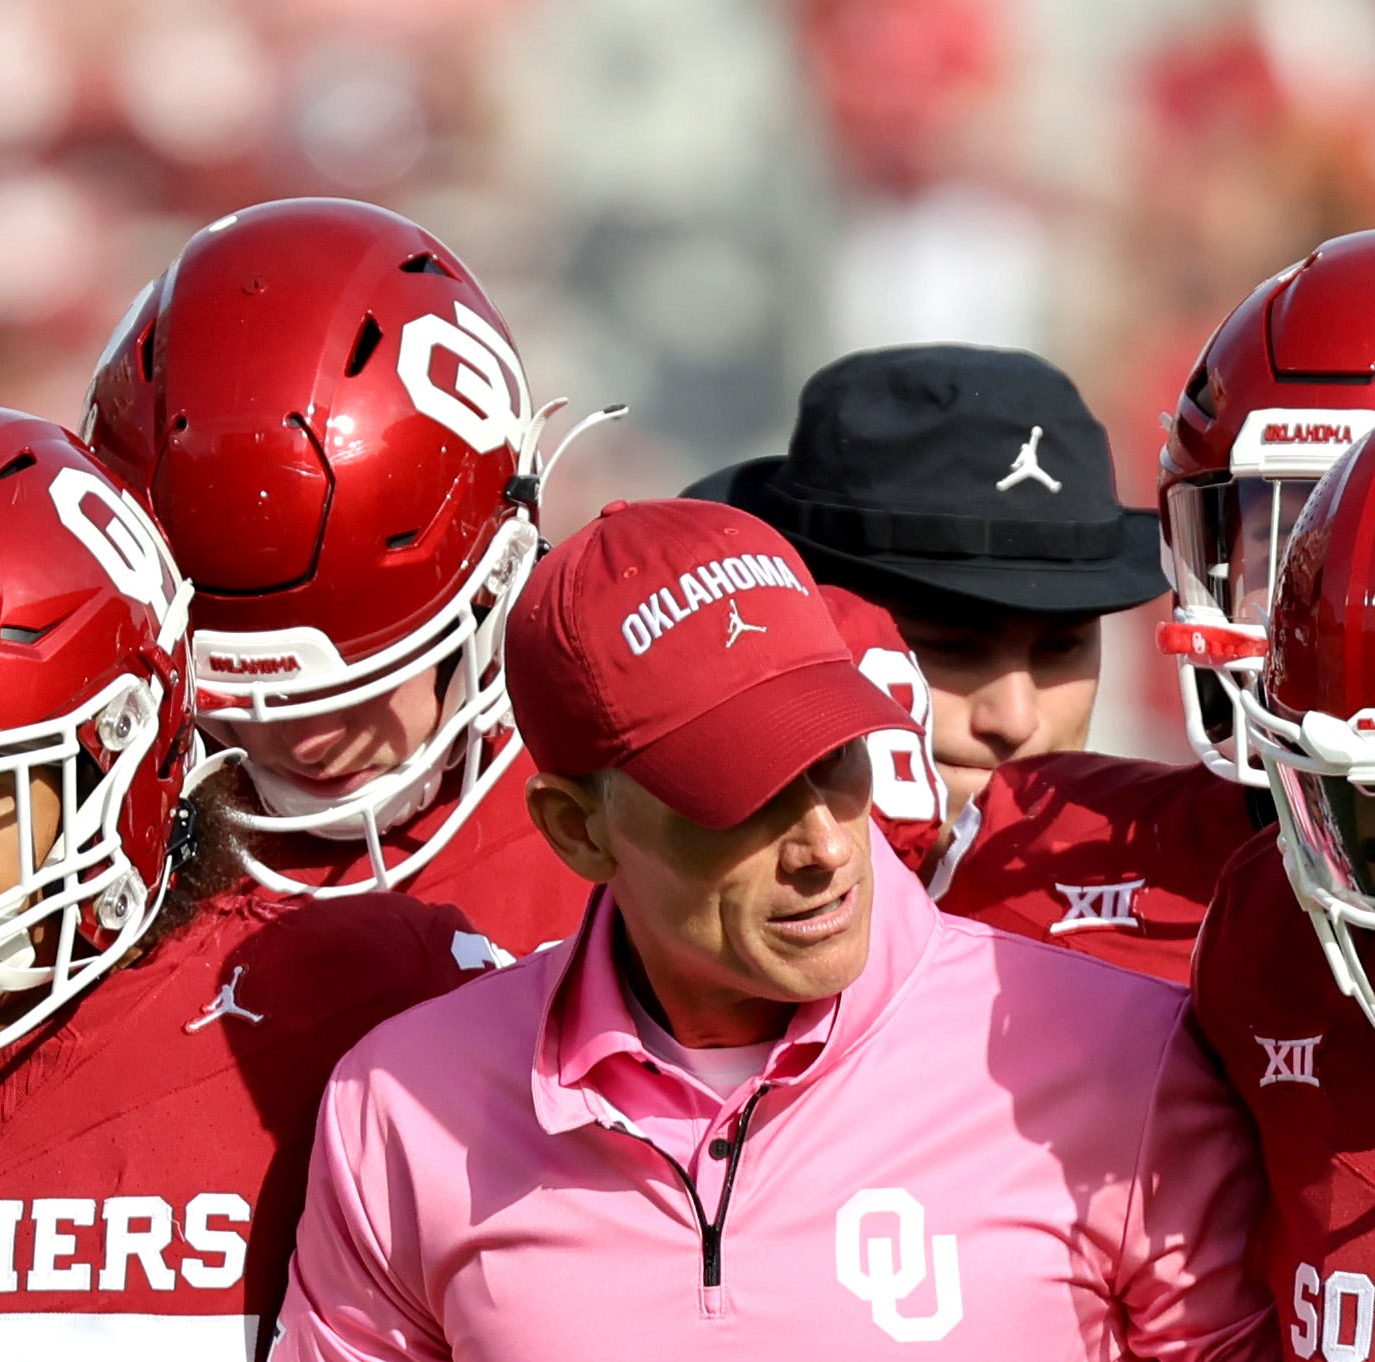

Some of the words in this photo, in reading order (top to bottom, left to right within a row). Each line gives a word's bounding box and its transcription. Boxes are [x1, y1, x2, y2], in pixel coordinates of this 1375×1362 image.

[1262, 423, 1353, 444] OKLAHOMA
[621, 553, 805, 656] OKLAHOMA
[1050, 879, 1145, 934] XII
[1254, 1035, 1322, 1088] XII
[836, 1187, 964, 1342] OU
